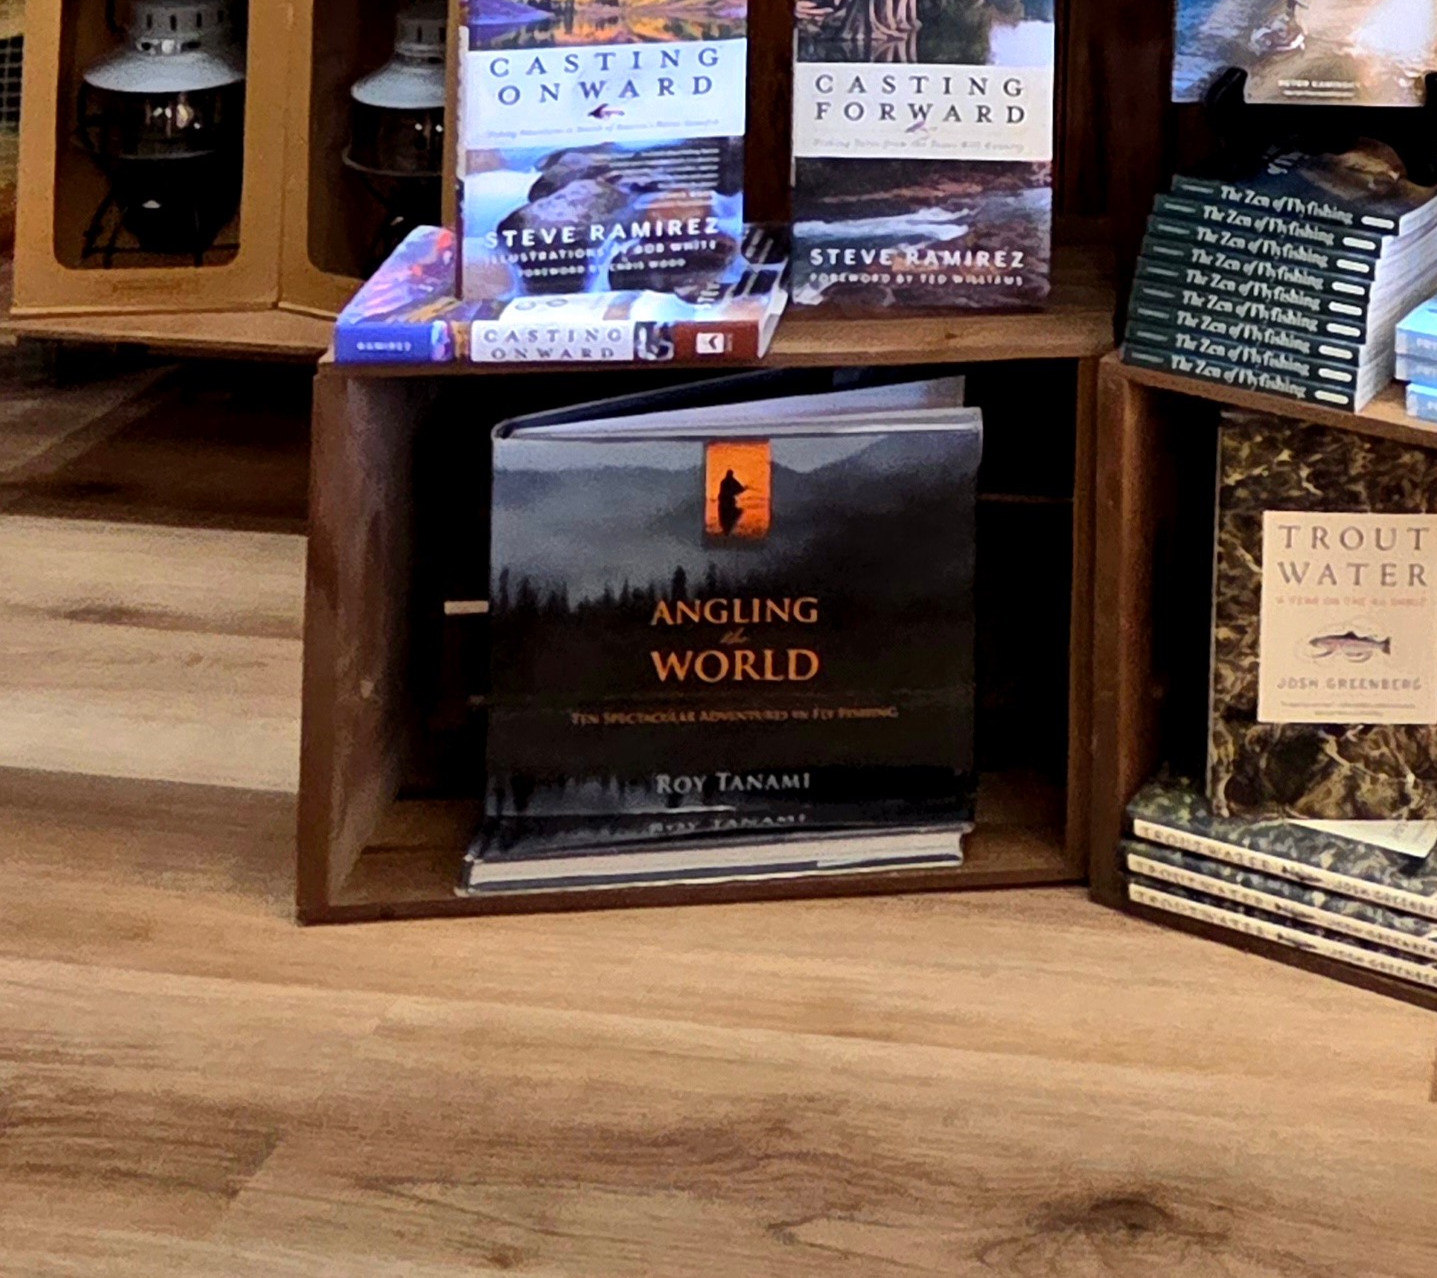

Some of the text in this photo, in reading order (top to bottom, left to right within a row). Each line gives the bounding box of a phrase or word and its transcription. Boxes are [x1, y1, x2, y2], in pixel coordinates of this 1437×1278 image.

[490, 47, 720, 78] CASTING
[498, 76, 714, 106] ONWARD
[815, 74, 1025, 98] CASTING
[814, 101, 1025, 124] FORWARD
[484, 217, 719, 248] STEVE RAMIREZ
[809, 248, 1025, 268] STEVE RAMIREZ
[483, 327, 622, 344] CASTING
[491, 346, 614, 360] ONWARD
[1278, 525, 1430, 551] TROUT
[1278, 561, 1429, 587] WATER
[650, 597, 819, 626] ANGLING
[650, 649, 819, 683] WORLD
[655, 770, 811, 794] ROY TANAMI
